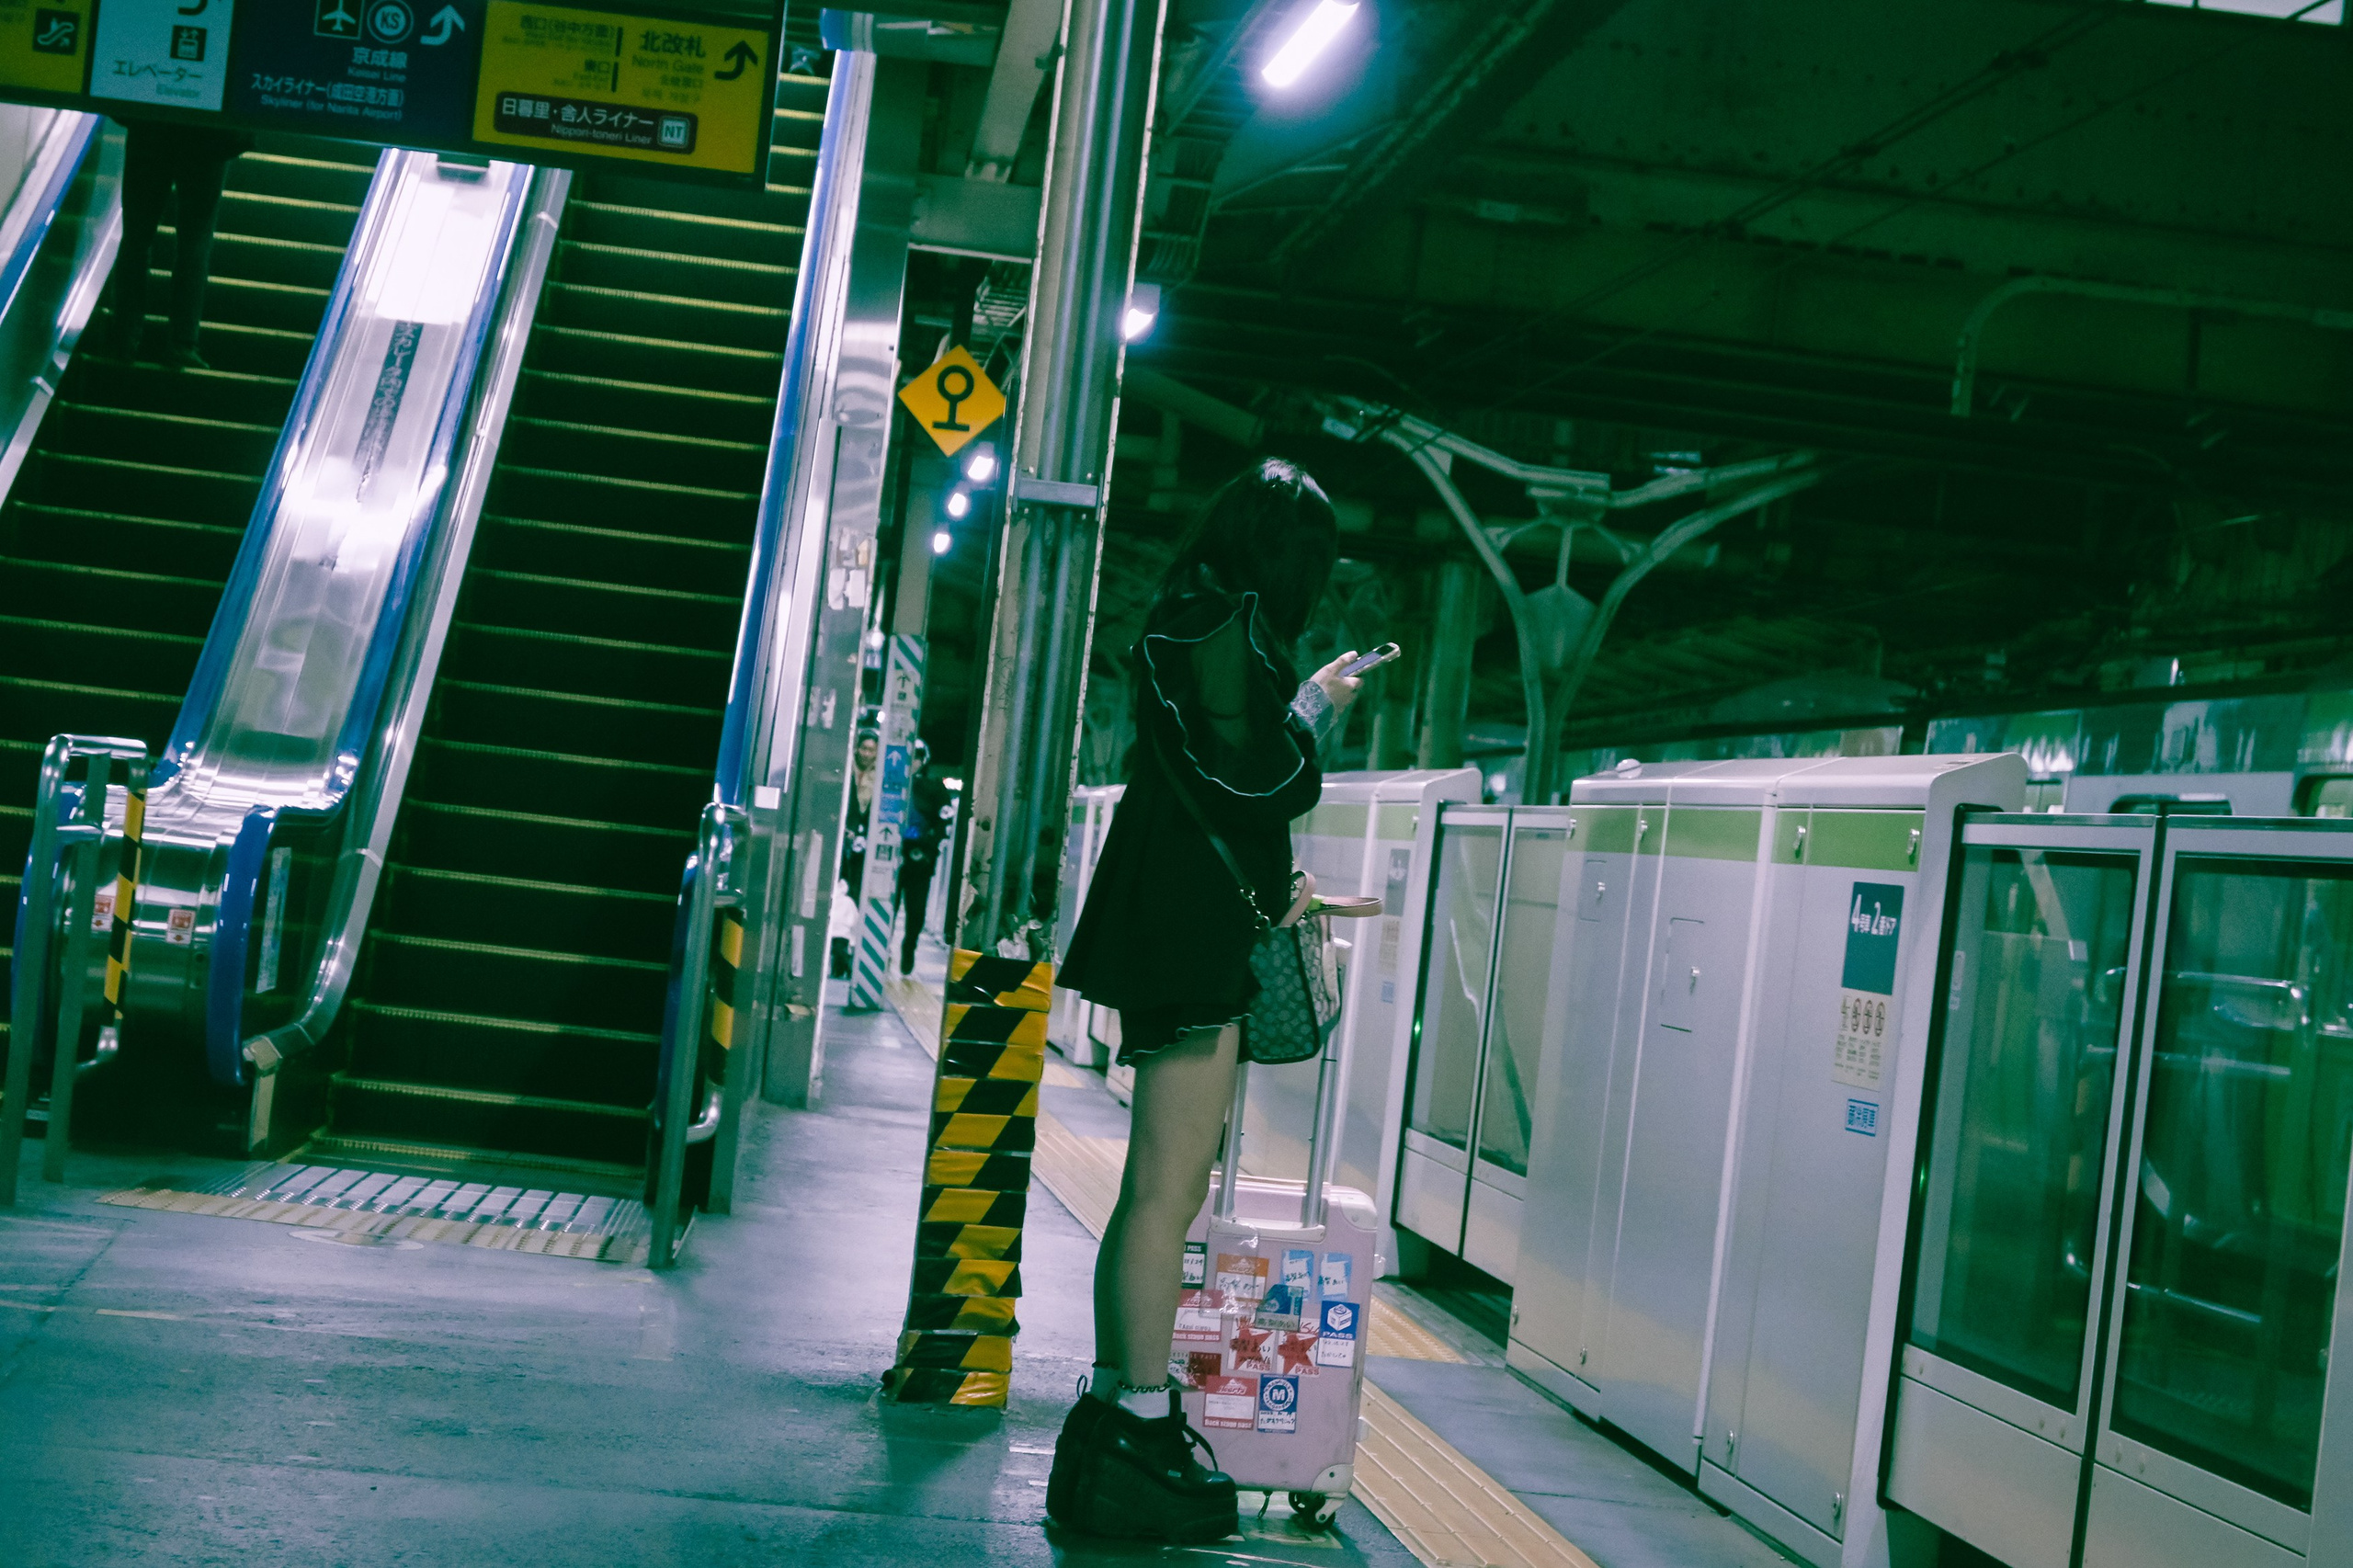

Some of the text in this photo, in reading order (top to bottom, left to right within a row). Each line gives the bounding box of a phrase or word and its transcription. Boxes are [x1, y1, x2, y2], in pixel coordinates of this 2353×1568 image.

[380, 10, 401, 29] KS
[639, 29, 707, 58] 北改札
[352, 46, 407, 69] 京成線
[631, 54, 705, 74] North Gate
[112, 59, 203, 82] エレベーター
[383, 71, 407, 83] Line
[260, 94, 303, 108] Skyliner
[502, 97, 654, 129] 日暮里・舎人ライナー
[625, 133, 653, 145] Liner
[664, 124, 685, 139] NT
[1246, 1361, 1270, 1371] PASS
[1295, 1365, 1319, 1375] PASS
[1272, 1389, 1286, 1401] M
